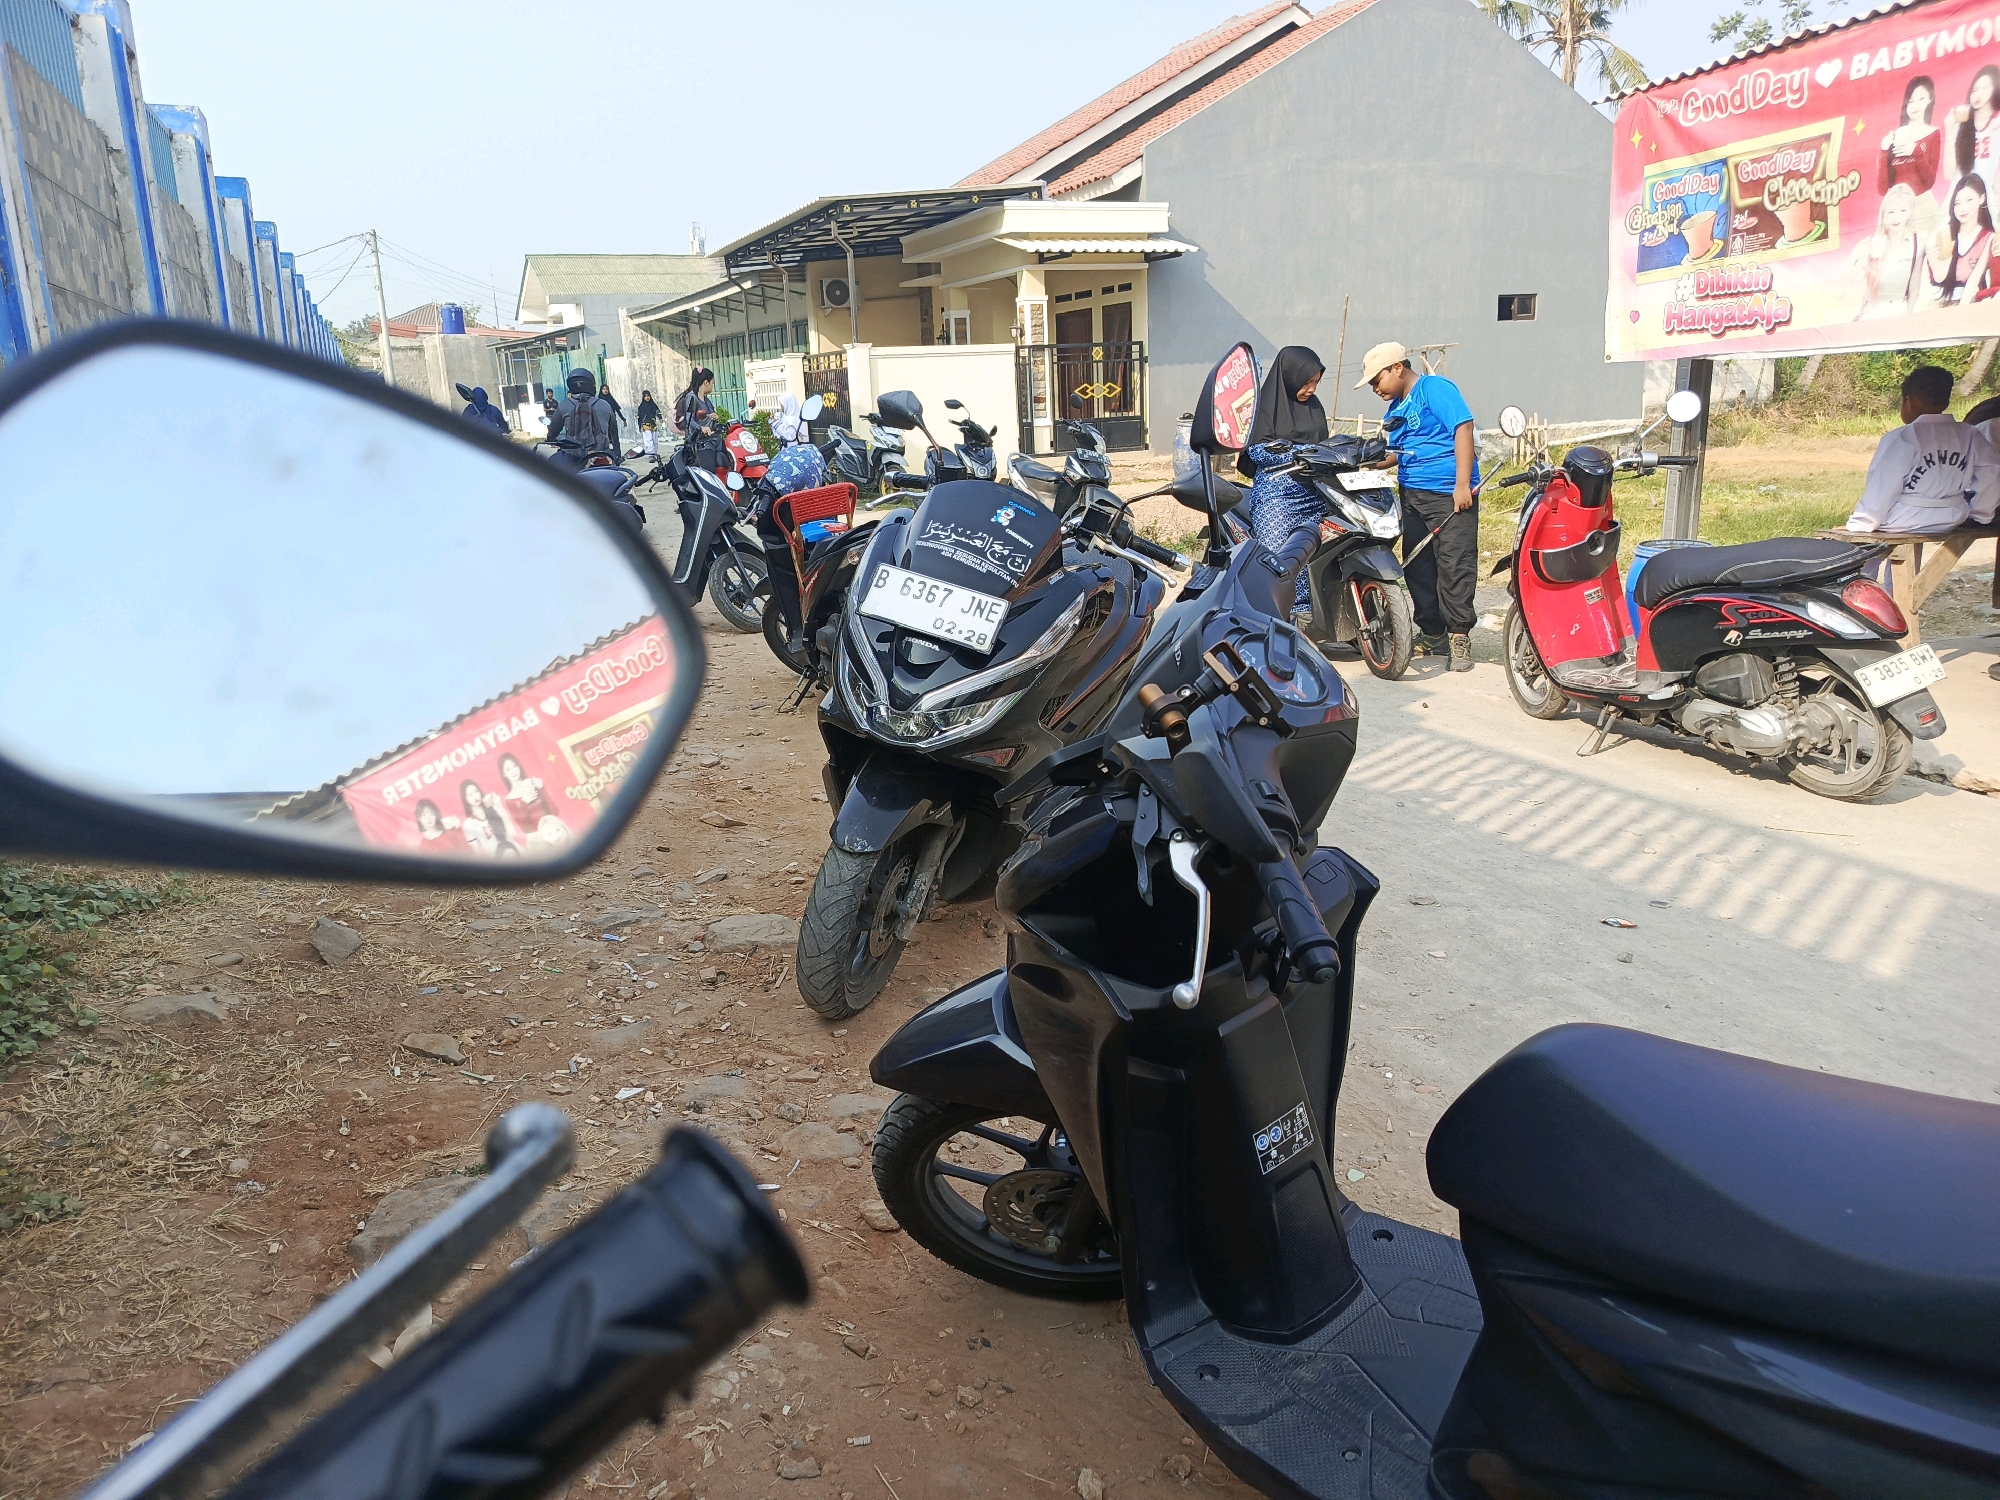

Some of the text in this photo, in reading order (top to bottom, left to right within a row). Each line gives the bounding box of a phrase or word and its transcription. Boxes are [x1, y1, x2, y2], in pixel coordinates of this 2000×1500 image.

[1675, 262, 1773, 301] #Dibikin
[981, 559, 1011, 582] KESULITAN
[874, 568, 1001, 623] B 6367 JNE
[905, 636, 940, 651] HONDA
[1745, 629, 1813, 639] Scoopy
[1860, 673, 1872, 687] B
[1874, 657, 1910, 681] 3835
